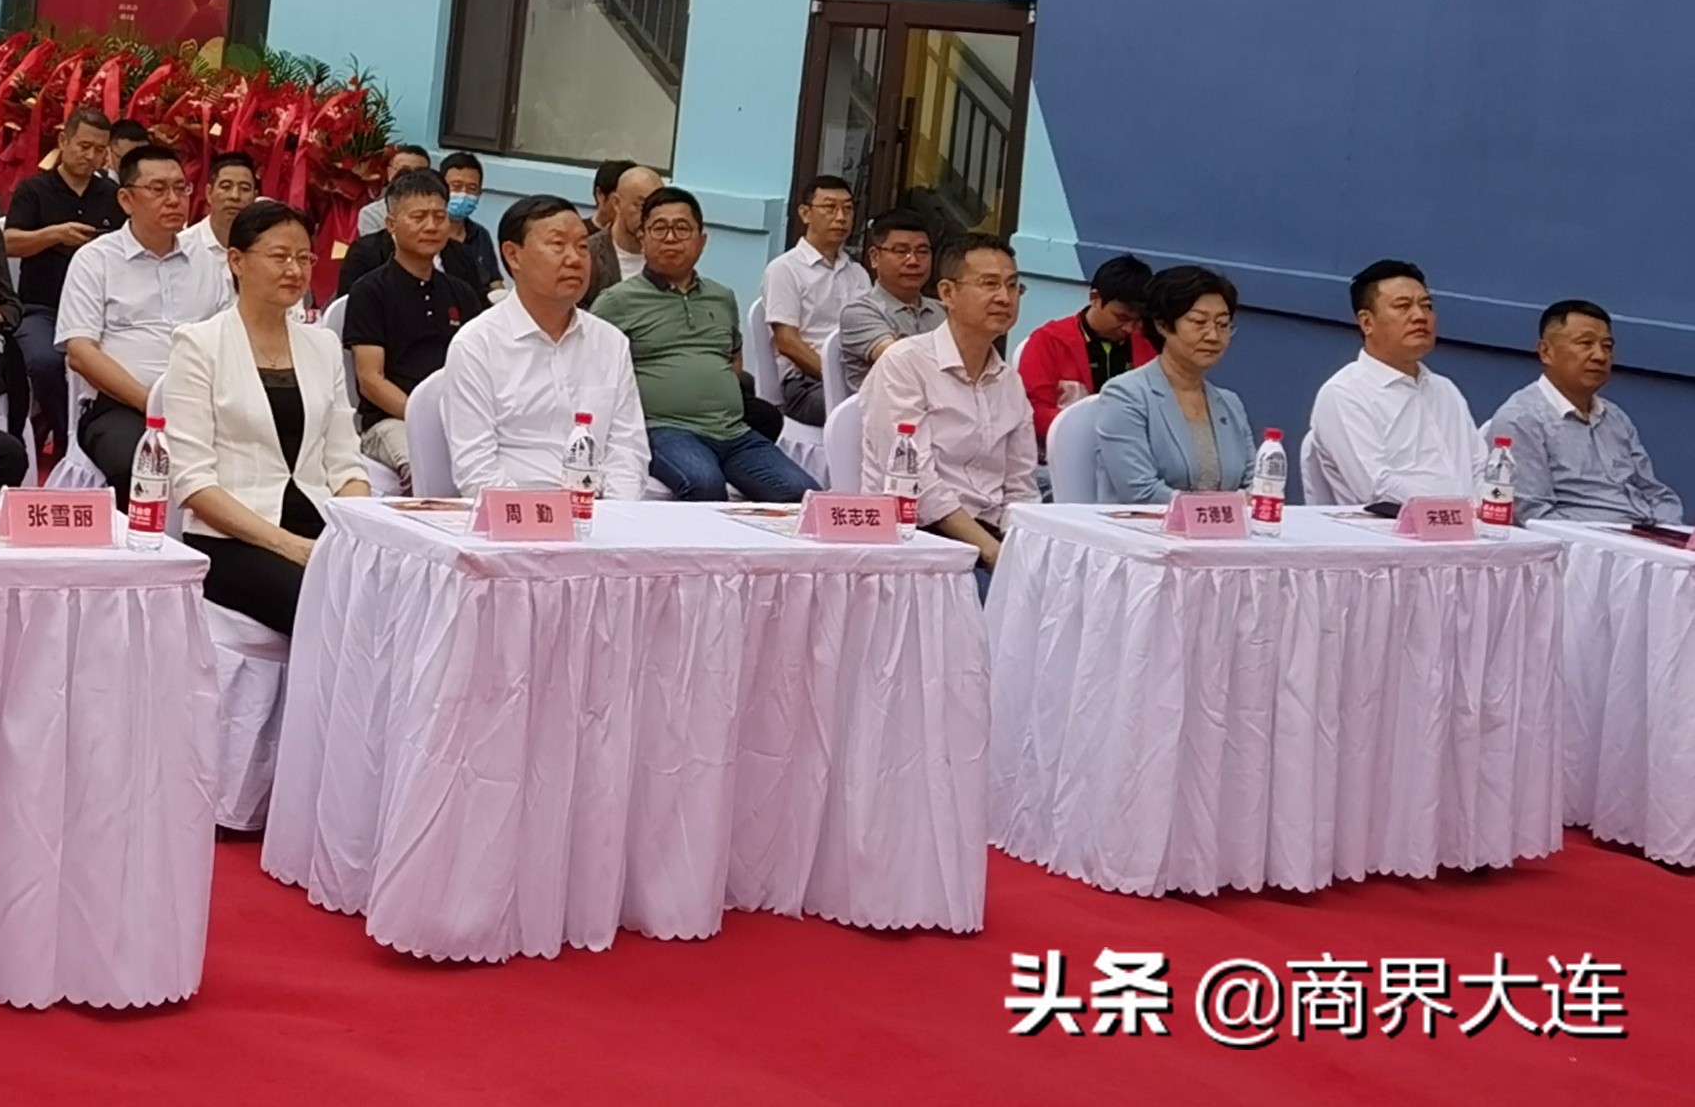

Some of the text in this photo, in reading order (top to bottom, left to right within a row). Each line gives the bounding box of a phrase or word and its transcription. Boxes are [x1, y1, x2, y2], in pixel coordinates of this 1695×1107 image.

[27, 504, 94, 527] 张雪丽
[830, 507, 881, 527] 张志宏
